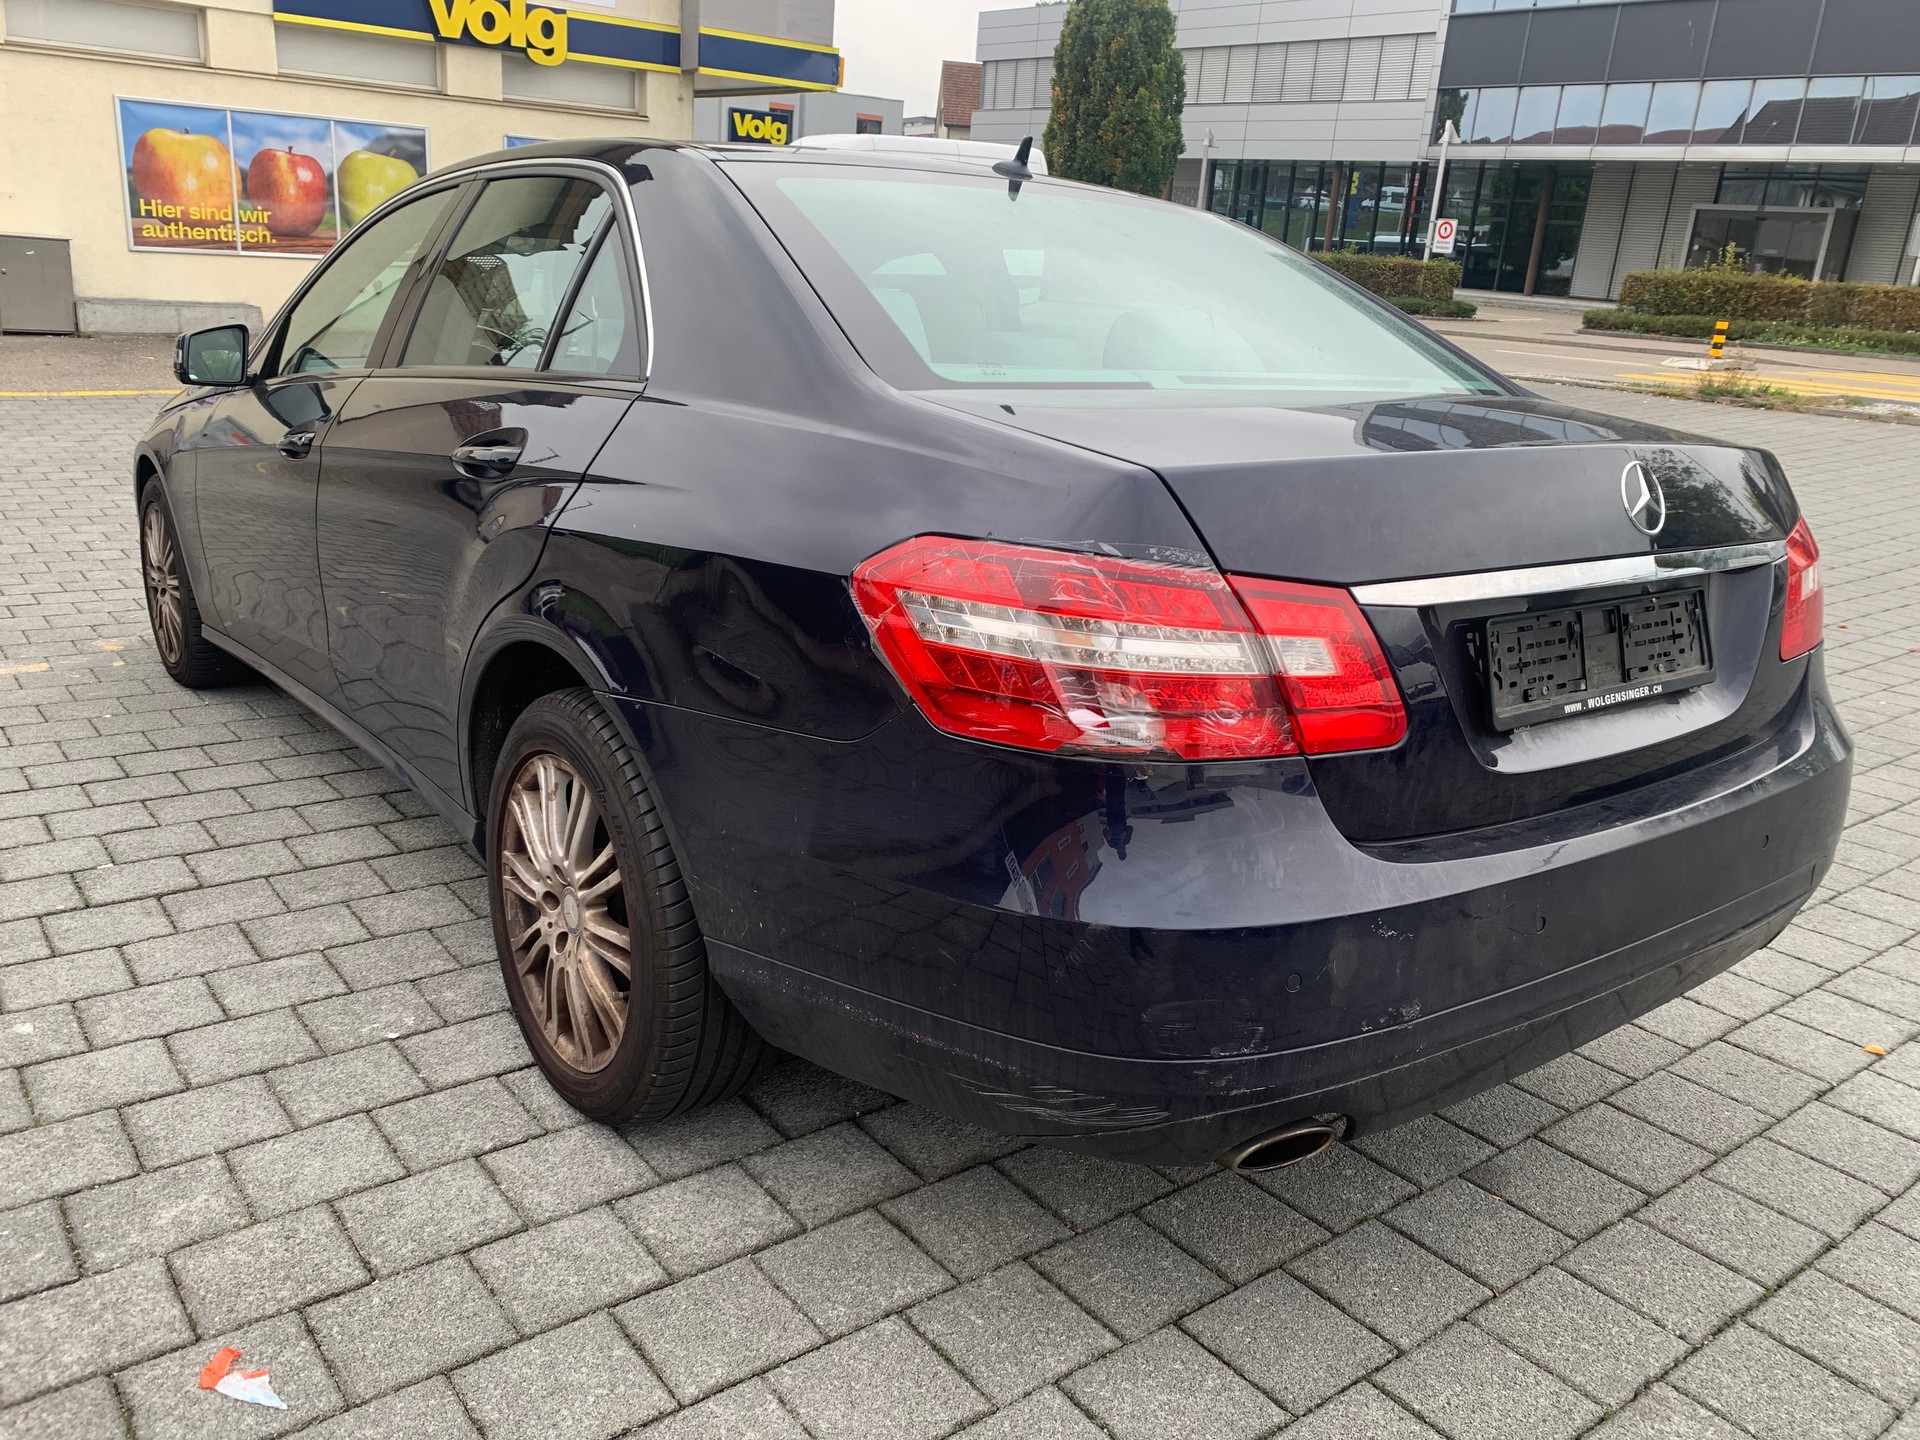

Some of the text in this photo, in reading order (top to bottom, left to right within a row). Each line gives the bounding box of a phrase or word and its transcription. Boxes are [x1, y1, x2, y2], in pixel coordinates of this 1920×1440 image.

[429, 0, 567, 66] Volg
[733, 112, 787, 145] Volg
[139, 198, 272, 223] Hier sind wir
[141, 222, 277, 244] authentisch.
